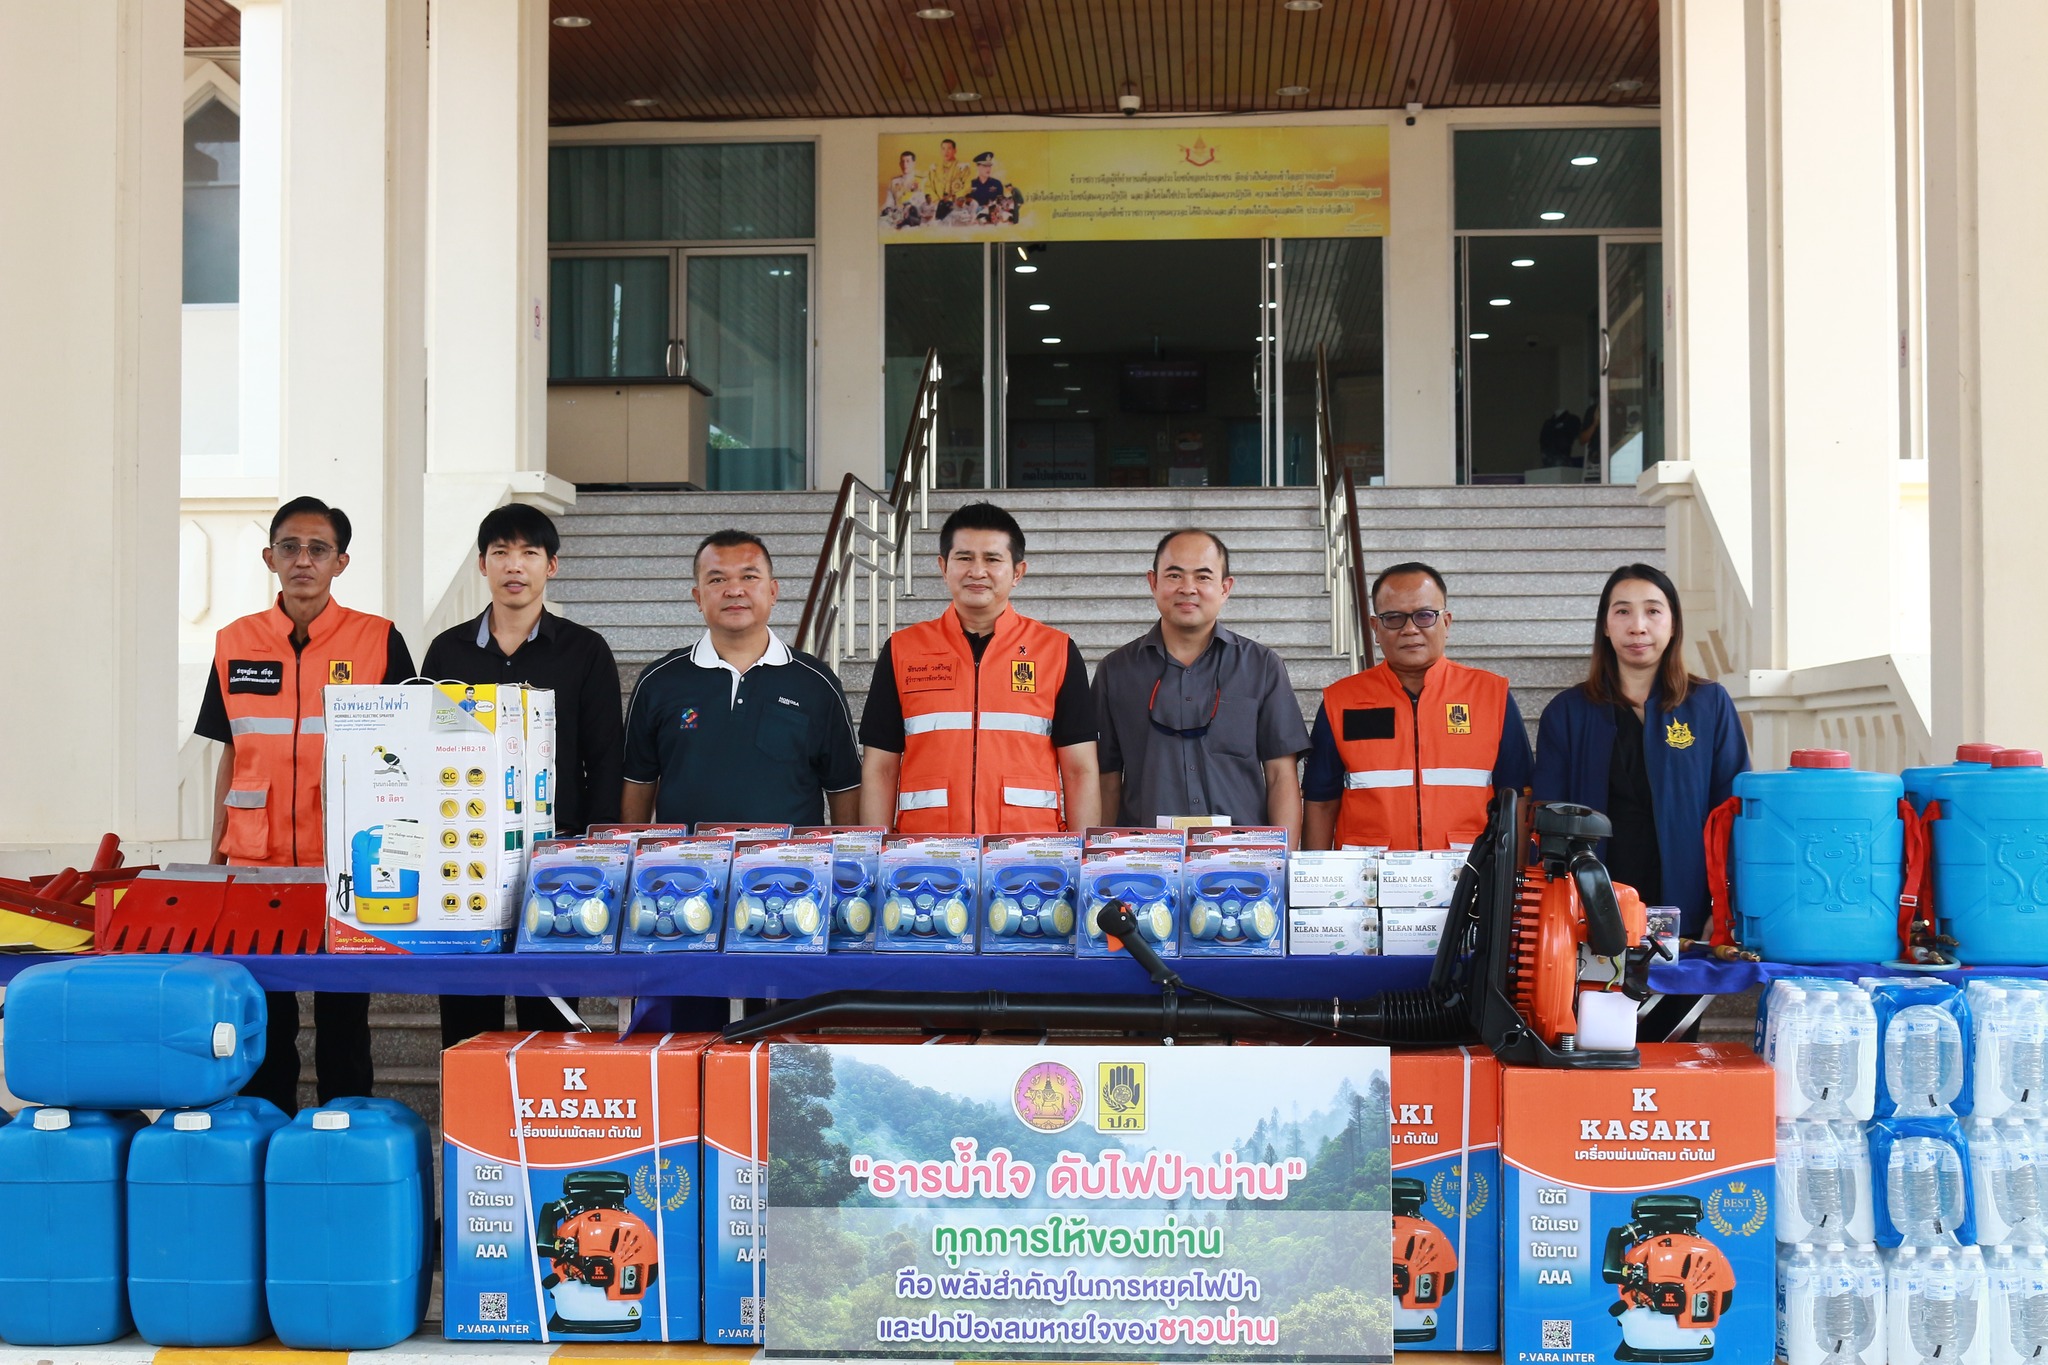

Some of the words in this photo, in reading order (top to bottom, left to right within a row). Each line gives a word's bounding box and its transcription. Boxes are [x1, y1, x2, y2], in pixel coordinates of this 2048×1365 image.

[333, 692, 409, 712] ถังพ่นยาไฟฟ้า
[563, 1067, 587, 1091] K
[518, 1098, 637, 1119] KASAKI
[1632, 1088, 1658, 1112] K
[1107, 1114, 1141, 1129] ปภ.
[510, 1122, 605, 1139] เรื่องพ่นพัดลม
[608, 1126, 642, 1139] ดับไฟ
[1403, 1131, 1439, 1145] ดับไฟ
[1580, 1120, 1711, 1141] KASAKI
[1574, 1144, 1676, 1162] เครื่องพ่นพัดลม
[1679, 1147, 1715, 1161] ดับไฟ
[474, 1163, 503, 1181] ใช้ดี
[853, 1139, 1032, 1194] "ธารน้ำใจ
[1050, 1153, 1303, 1195] ดับไฟป่าน่าน"
[1446, 1181, 1473, 1191] BET
[467, 1189, 514, 1207] ใช้แรง
[1537, 1188, 1567, 1205] ใช้ดี
[1723, 1197, 1752, 1208] BEST
[468, 1216, 513, 1233] ใช้นาน
[1530, 1215, 1579, 1232] ใช้แรง
[934, 1216, 1221, 1264] ทุกการให้ของท่าน
[475, 1244, 508, 1258] AAA
[1530, 1242, 1577, 1258] ใช้นาน
[1538, 1269, 1572, 1284] AAA
[897, 1270, 933, 1297] คือ
[940, 1269, 1258, 1305] พลังสำคัญในการหยุดไฟป่า
[457, 1323, 495, 1334] P.VARA
[498, 1323, 530, 1334] INTER
[880, 1308, 1276, 1343] และปกป้องลมหายใจของชาวน่าน
[1519, 1351, 1560, 1363] P.VARA
[1562, 1351, 1595, 1363] INTER
